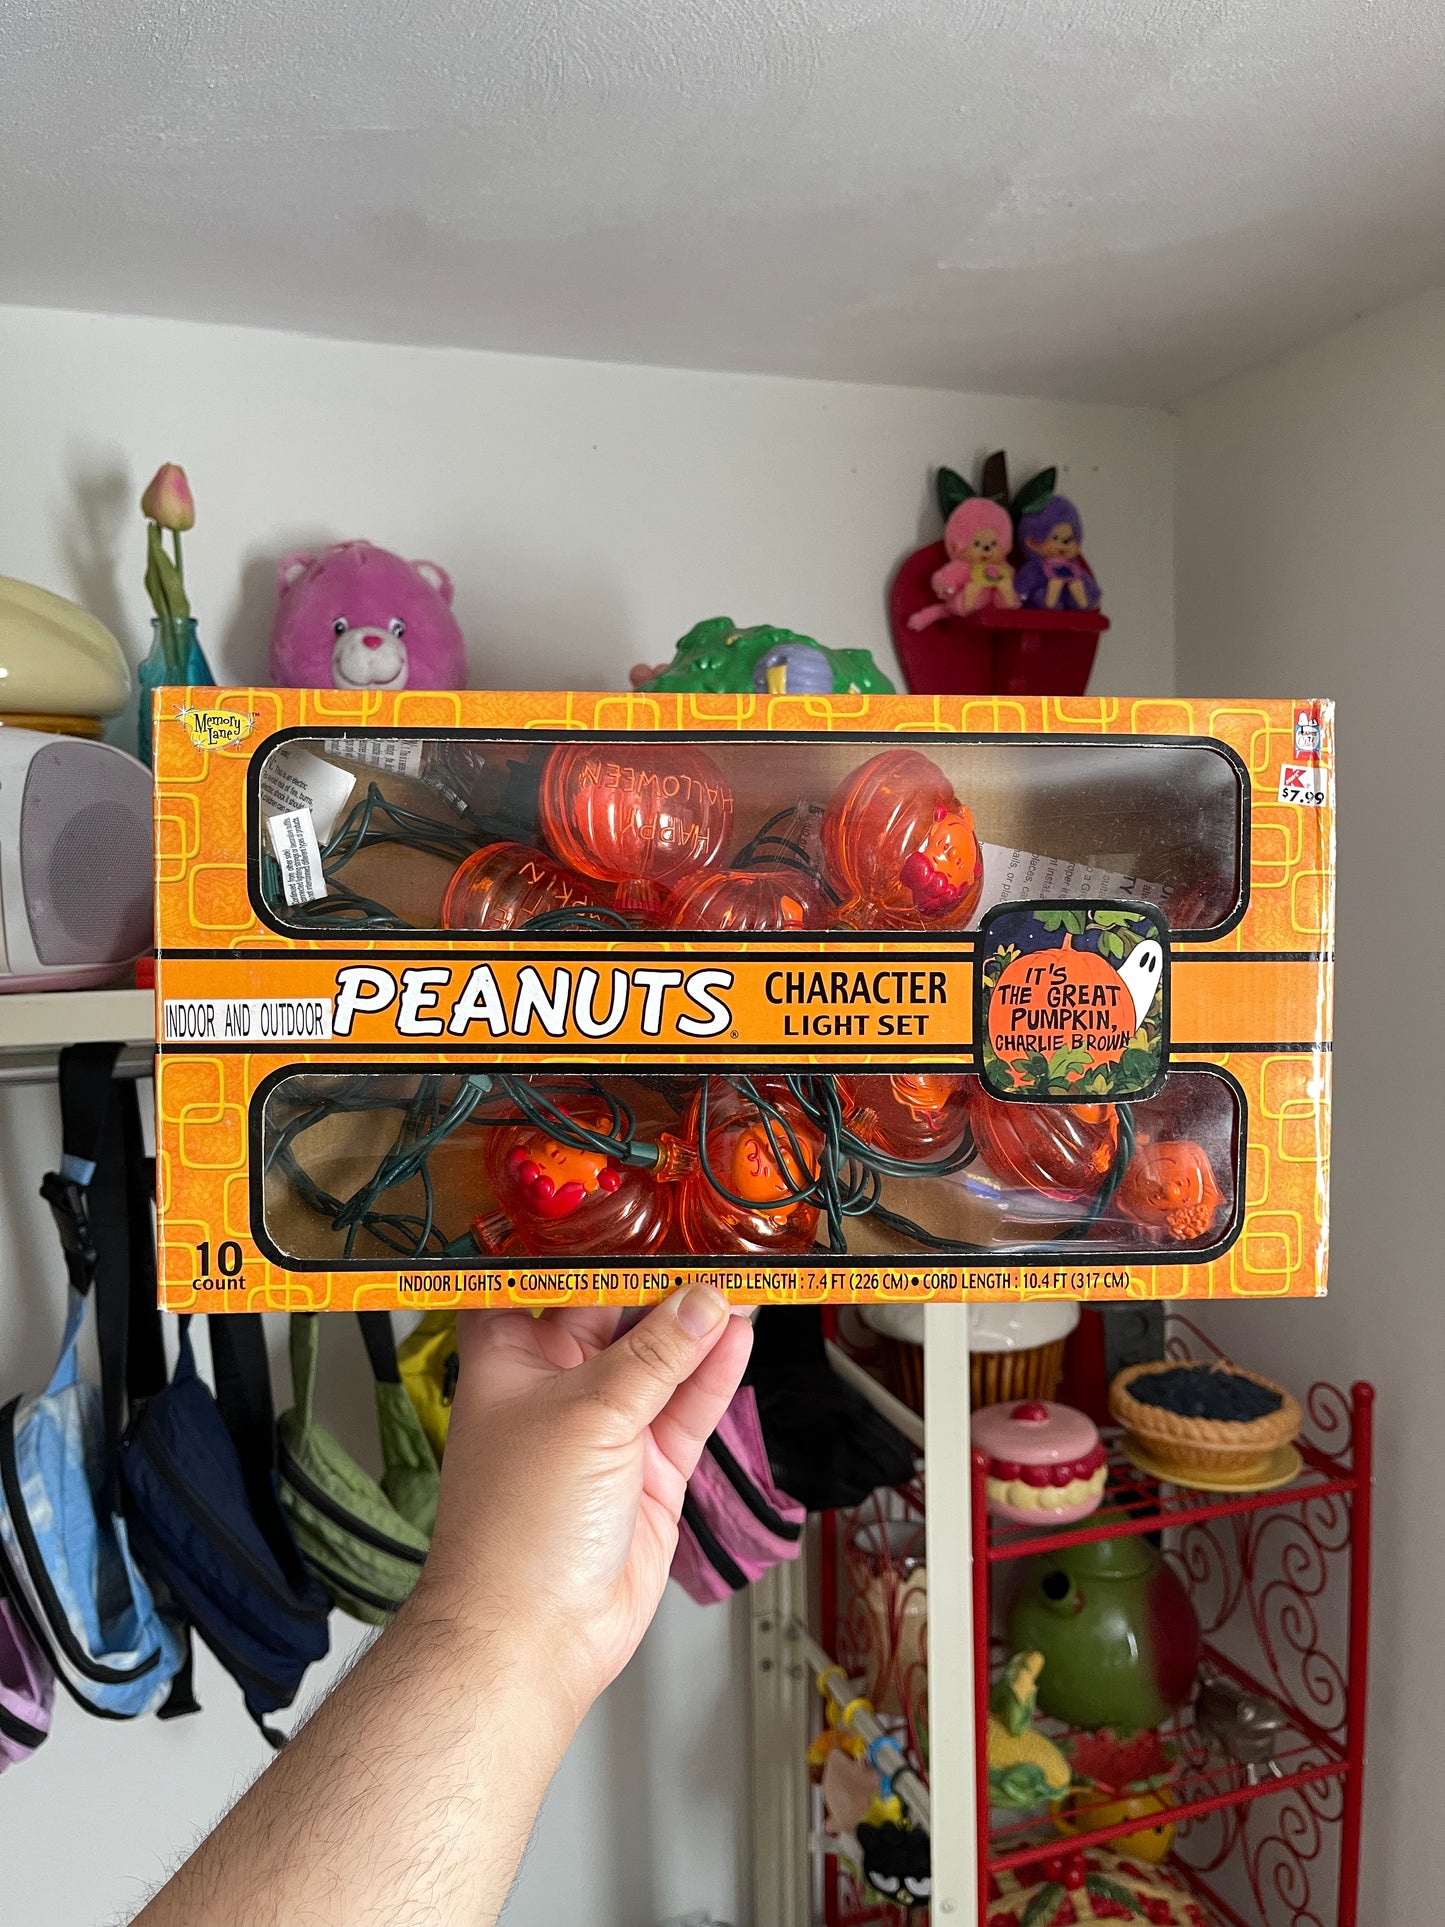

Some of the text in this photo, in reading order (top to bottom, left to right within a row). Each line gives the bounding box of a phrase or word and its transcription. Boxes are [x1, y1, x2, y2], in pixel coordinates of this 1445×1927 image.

[194, 713, 240, 735] Memory
[208, 728, 233, 745] Lane
[580, 760, 733, 814] HALLOWEEN
[1282, 787, 1324, 805] $7.99
[620, 808, 710, 854] HAPPY
[1006, 873, 1014, 882] or
[1026, 963, 1067, 985] IT'S
[765, 971, 947, 1004] CHARACTER
[998, 984, 1120, 1008] THE GREAT
[332, 964, 734, 1038] PEANUTS
[166, 1003, 323, 1037] INDOOR AND OUTDOOR
[784, 1015, 929, 1035] LIGHT SET
[1011, 1008, 1117, 1032] PUMPKIN,
[995, 1031, 1130, 1052] CHARLIE BROWN
[196, 1241, 242, 1276] 10
[192, 1276, 246, 1290] count
[399, 1275, 450, 1292] INDOOR
[455, 1275, 501, 1291] LIGHTS
[520, 1274, 589, 1291] CONNECTS
[593, 1274, 619, 1290] END
[622, 1274, 638, 1290] TO
[643, 1273, 669, 1290] END
[807, 1273, 827, 1289] 7.4
[832, 1273, 845, 1289] FT
[850, 1273, 879, 1290] (226
[883, 1273, 909, 1290] CM)
[923, 1273, 957, 1289] CORD
[1023, 1273, 1050, 1289] 10.4
[1053, 1273, 1067, 1288] FT
[1071, 1272, 1100, 1290] (317
[1103, 1272, 1130, 1289] CM)
